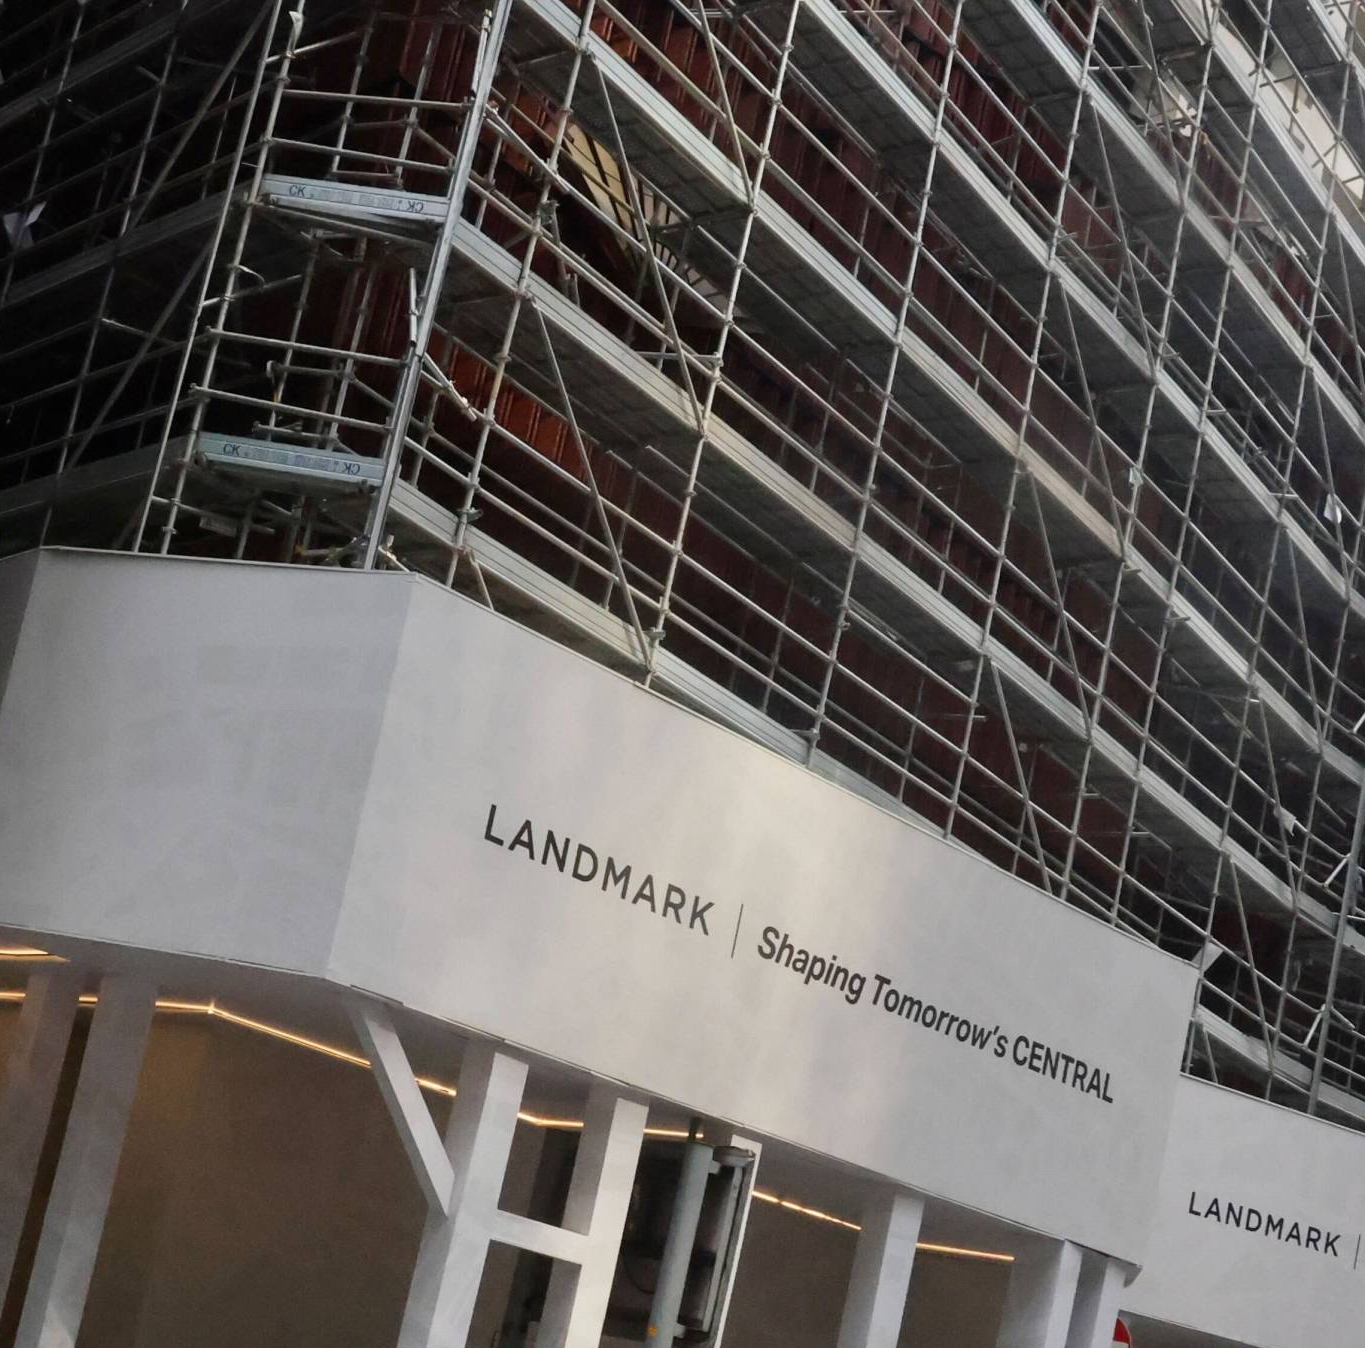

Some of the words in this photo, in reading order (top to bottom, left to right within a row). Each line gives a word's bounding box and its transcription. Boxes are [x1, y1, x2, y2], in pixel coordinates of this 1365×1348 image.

[483, 804, 716, 937] LANDMARK
[757, 926, 867, 1006] Shaping
[871, 974, 1009, 1058] Tomorrow's
[1013, 1035, 1116, 1104] CENTRAL
[1188, 1191, 1341, 1257] LANDMARK
